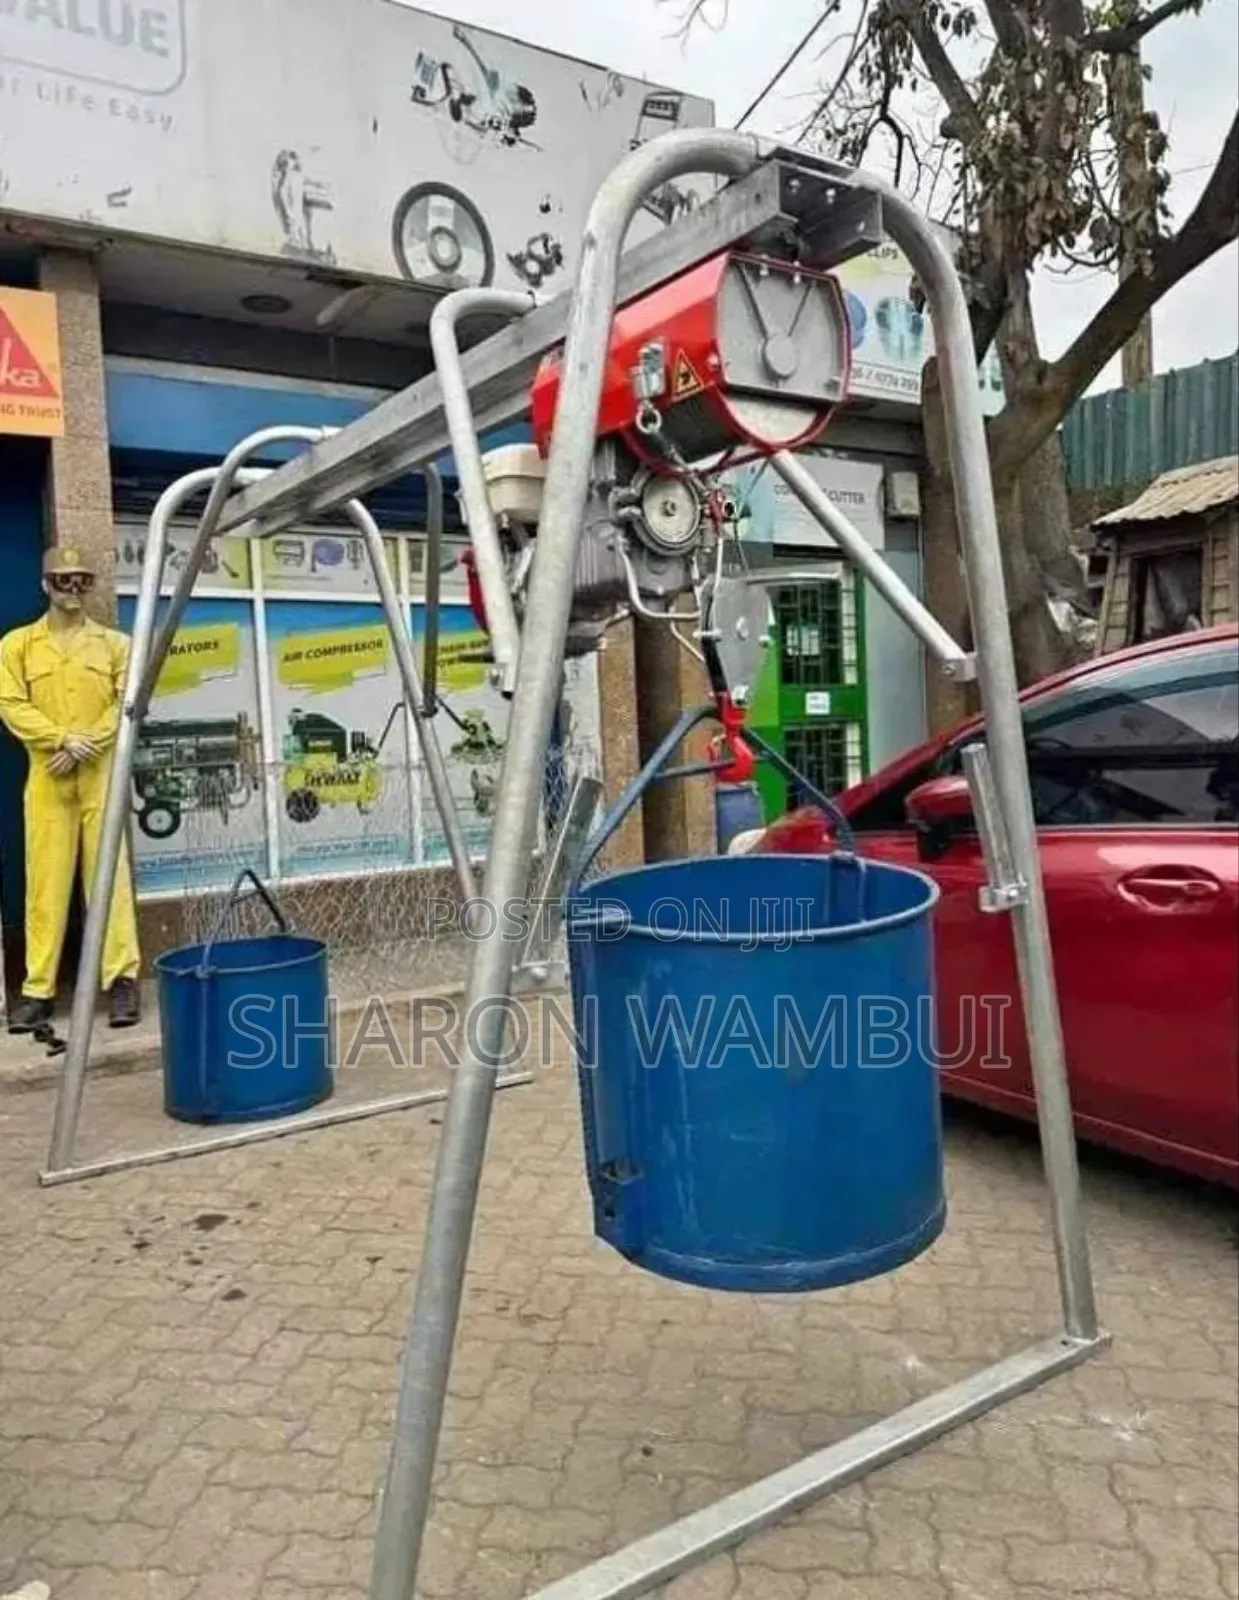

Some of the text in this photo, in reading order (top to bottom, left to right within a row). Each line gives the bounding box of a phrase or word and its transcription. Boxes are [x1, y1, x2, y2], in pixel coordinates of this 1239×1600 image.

[0, 337, 41, 388] ka
[19, 405, 61, 419] TRUST
[169, 640, 219, 656] RATORS
[282, 639, 384, 661] AIR COMPRESSOR
